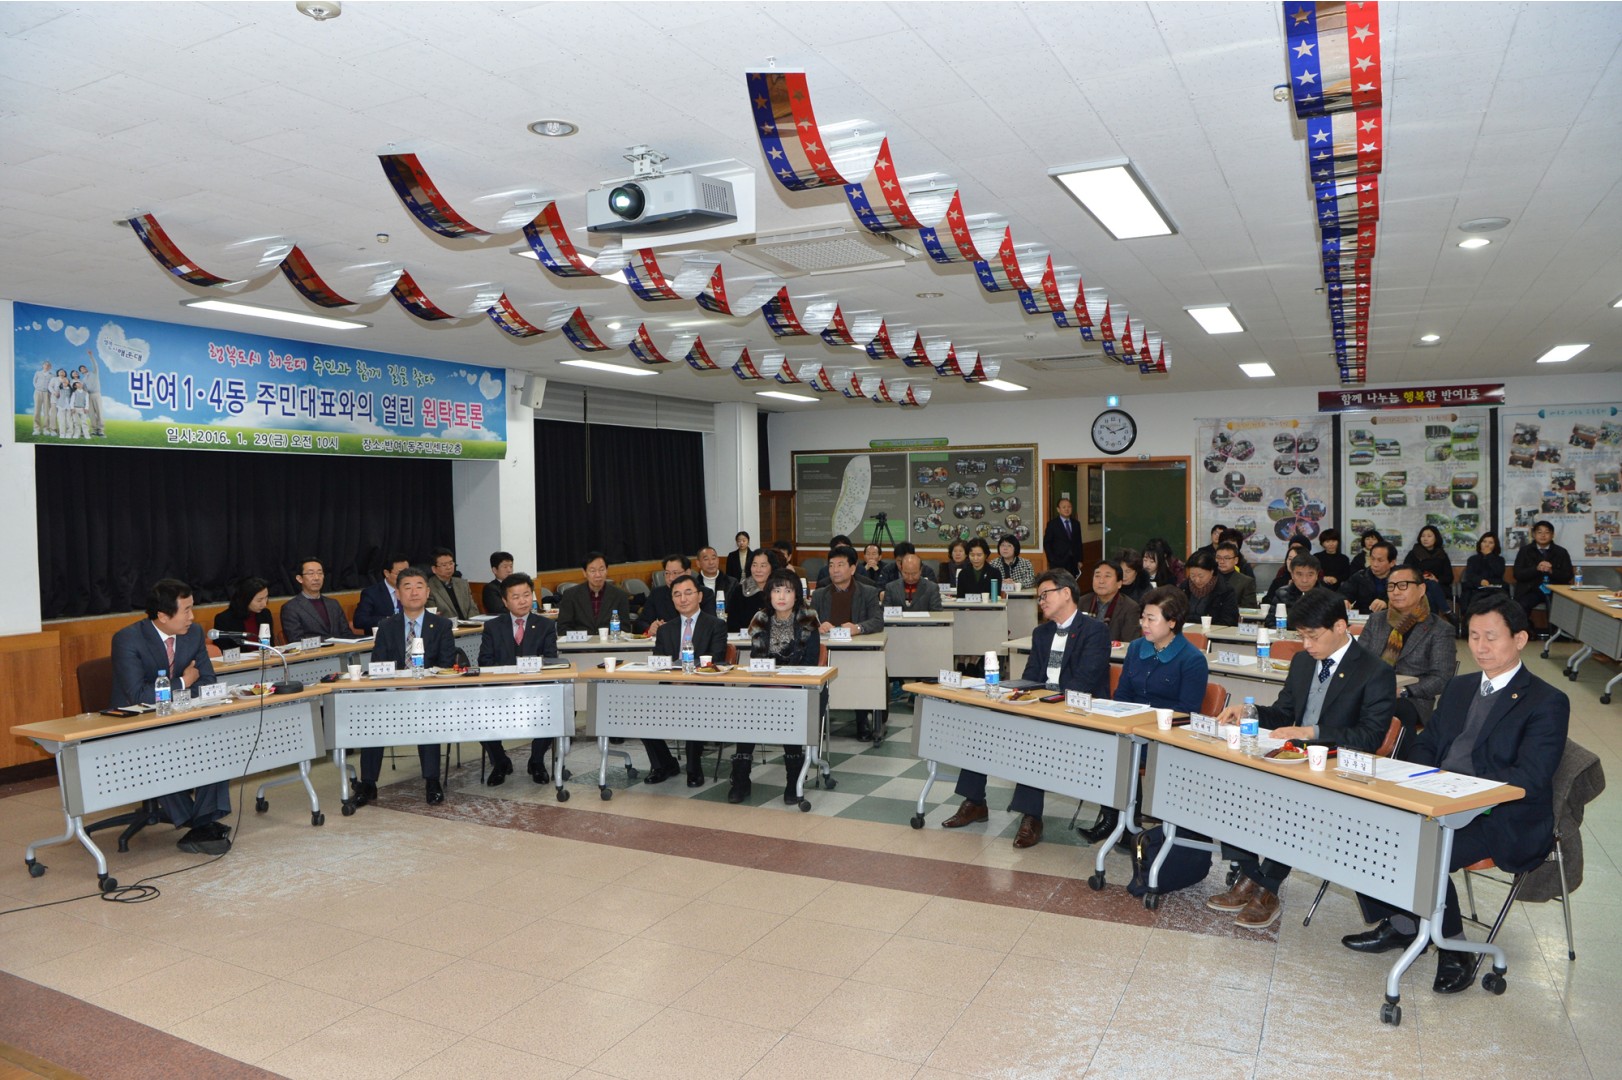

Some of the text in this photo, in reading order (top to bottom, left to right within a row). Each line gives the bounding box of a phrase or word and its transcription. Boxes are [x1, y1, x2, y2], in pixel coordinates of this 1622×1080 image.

[209, 343, 435, 387] 행복도시 해운대 주민과 함께 길을 찾다
[130, 371, 483, 430] 반여1·4동 주민대표와의 열린 원탁토론
[1341, 393, 1362, 406] 함께
[1367, 391, 1400, 404] 나누는
[1403, 390, 1437, 403] 행복한
[167, 428, 230, 444] 일시:2016.
[254, 433, 288, 447] 29(금)
[291, 435, 312, 448] 오전
[317, 437, 338, 449] 10시
